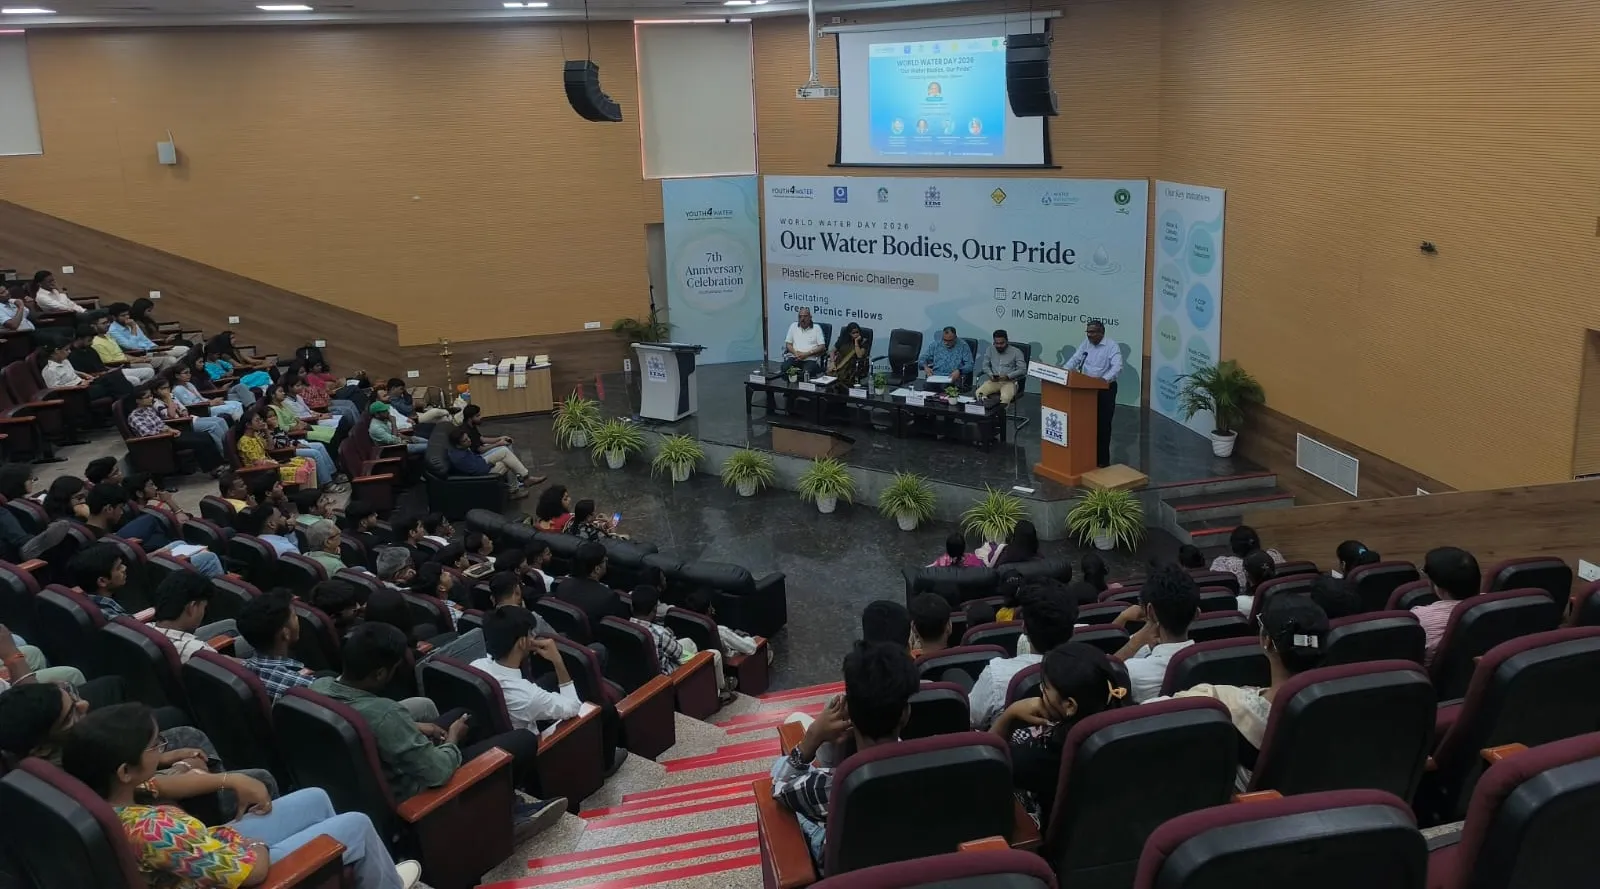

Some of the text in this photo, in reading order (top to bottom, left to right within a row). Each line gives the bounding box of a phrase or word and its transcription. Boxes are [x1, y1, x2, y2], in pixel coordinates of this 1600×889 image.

[920, 58, 942, 66] WATER
[1165, 188, 1175, 198] Our
[1176, 189, 1184, 200] Key
[780, 218, 813, 226] WORLD
[819, 219, 851, 228] WATER
[883, 222, 910, 230] 2026
[780, 230, 1076, 265] Our Water Bodies, Our Pride
[706, 252, 722, 262] 7th
[686, 265, 744, 276] Anniversary
[686, 276, 744, 288] Celebration
[782, 268, 914, 288] Plastic-Free Picnic Challenge
[783, 292, 829, 304] Felicitating
[1011, 290, 1080, 304] 21 March 2026
[813, 306, 843, 317] Picnic
[845, 308, 883, 320] Fellows
[1011, 308, 1025, 318] IIM
[1027, 310, 1077, 324] Sambalpur
[1046, 429, 1063, 440] IIM
